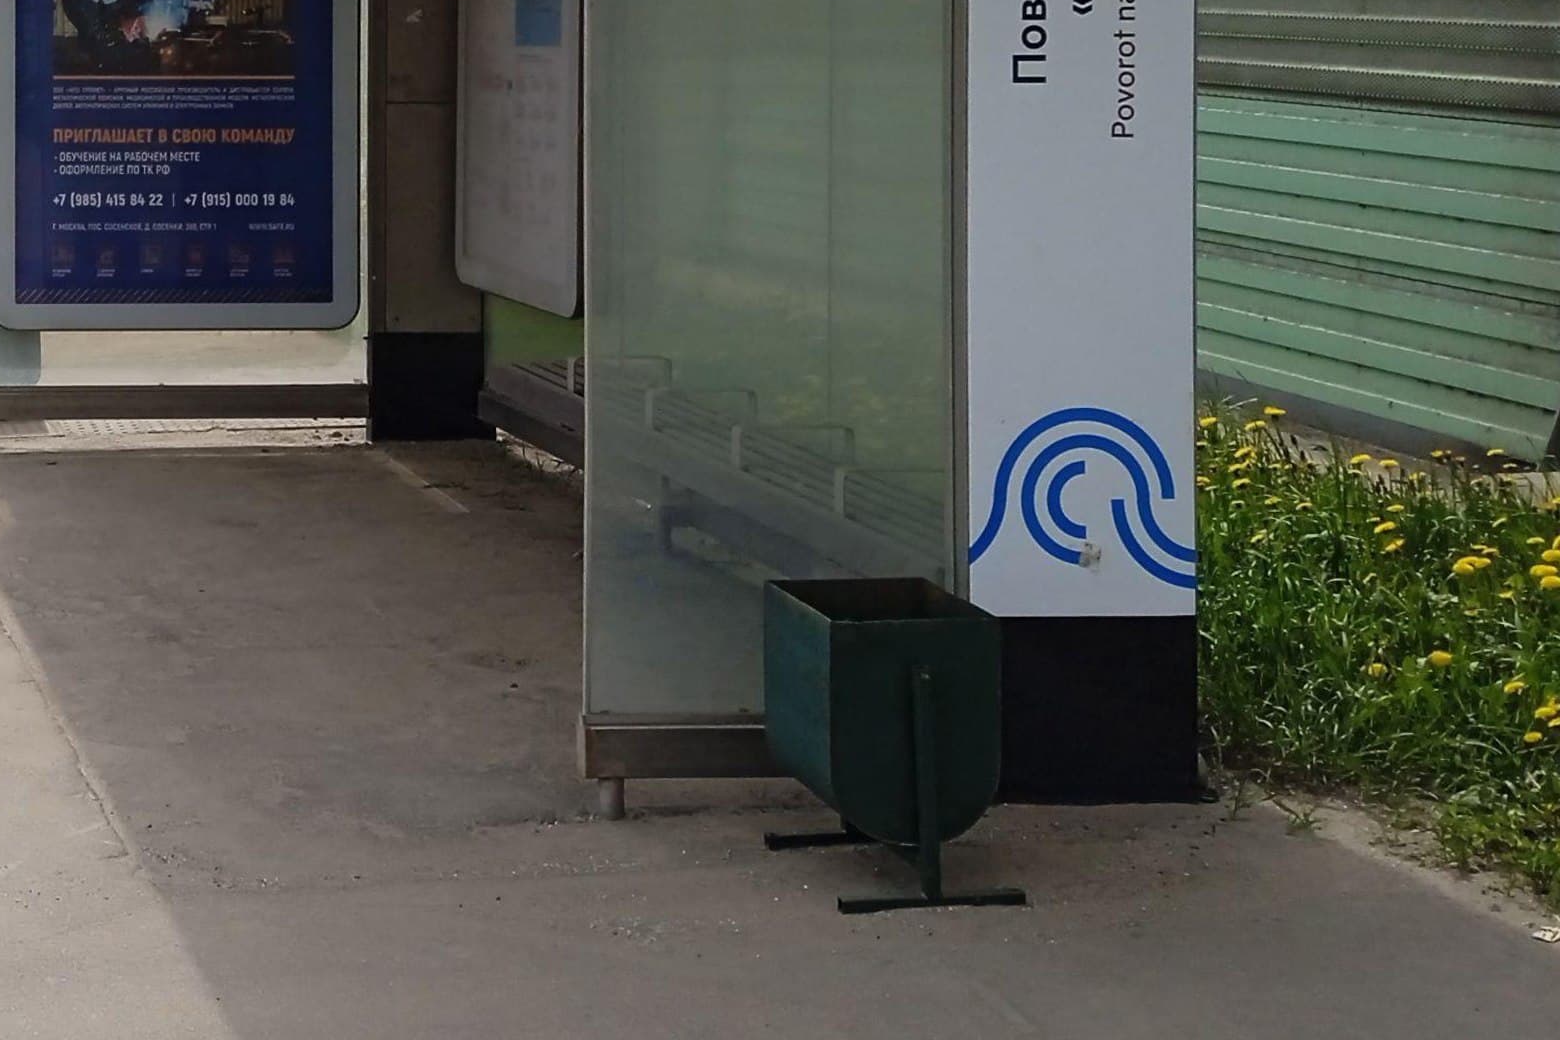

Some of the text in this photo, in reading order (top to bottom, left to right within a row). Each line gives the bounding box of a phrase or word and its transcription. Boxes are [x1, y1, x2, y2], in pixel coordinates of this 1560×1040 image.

[1111, 29, 1136, 138] Povorot
[53, 128, 295, 145] ПРИГЛАШАЕТ В СВОЮ КОМАНДУ
[59, 151, 200, 162] ОБУЧЕНИЕ НА РАБОЧЕМ МЕСТЕ
[59, 164, 170, 176] ОФОРМЛЕНИЕ ПО ТК РФ
[53, 192, 163, 206] +7 (985) 415 84 22
[184, 192, 295, 206] +7 (915) 000 19 84
